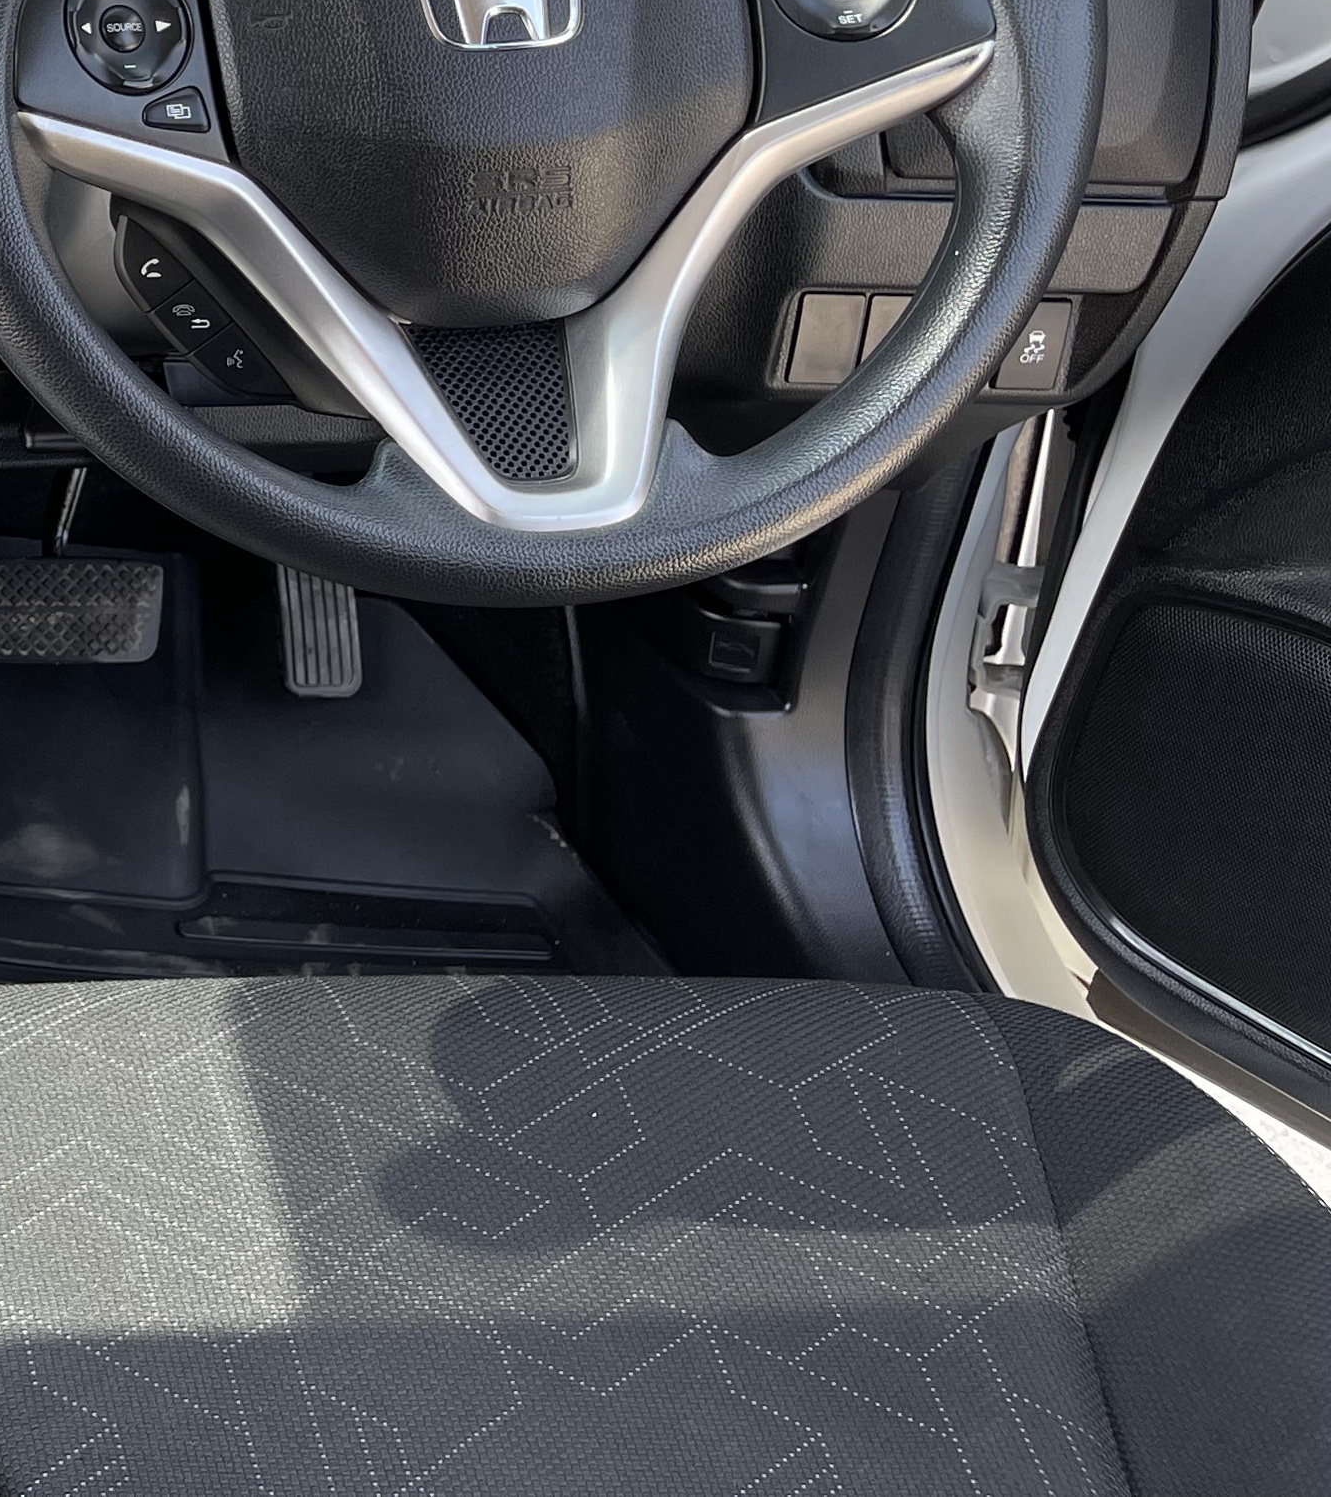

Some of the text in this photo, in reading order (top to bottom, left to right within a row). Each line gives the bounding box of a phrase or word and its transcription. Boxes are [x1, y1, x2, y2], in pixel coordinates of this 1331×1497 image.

[838, 13, 863, 26] SET
[106, 22, 143, 34] SOURCE
[1019, 353, 1046, 364] OFF
